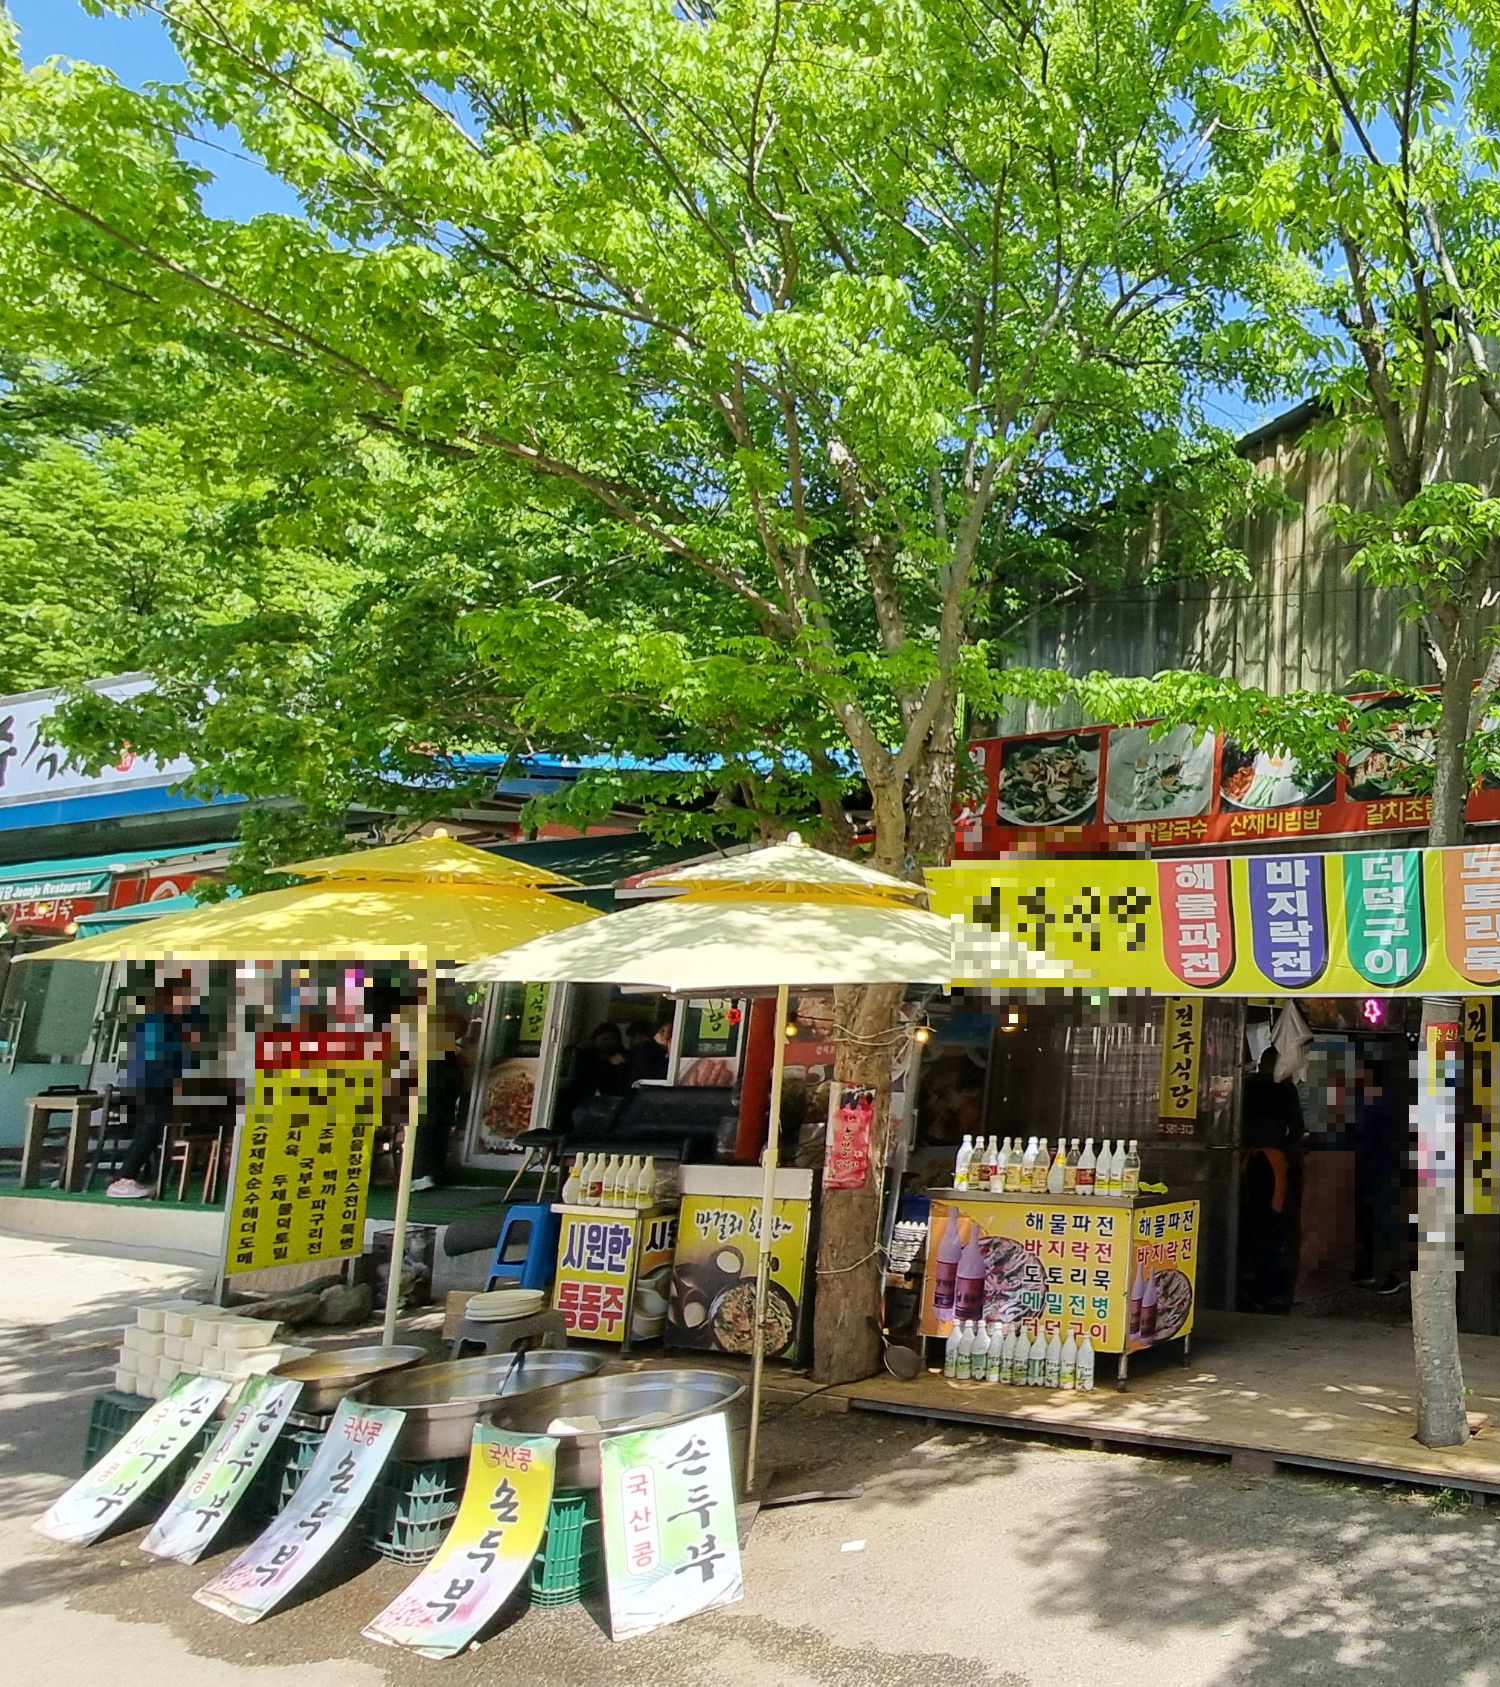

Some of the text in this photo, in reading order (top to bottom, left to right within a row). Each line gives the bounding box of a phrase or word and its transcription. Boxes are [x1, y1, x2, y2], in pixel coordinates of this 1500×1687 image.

[1230, 809, 1322, 836] 산채비빔밥
[42, 879, 92, 895] Restaurant
[1175, 863, 1221, 978] 해물파전
[1265, 860, 1313, 978] 바지락전
[1361, 855, 1409, 977] 더덕구이
[1170, 1004, 1195, 1108] 전주식당
[696, 1210, 743, 1241] 막걸리
[1025, 1212, 1114, 1237] 해물파전
[1139, 1209, 1194, 1238] 해물파전
[562, 1222, 632, 1272] 시원한
[1024, 1239, 1113, 1264] 바지락전
[1137, 1237, 1192, 1266] 바지락전
[1023, 1264, 1111, 1291] 도토리묵
[558, 1282, 624, 1333] 동동주
[1022, 1291, 1109, 1319] 메밀전병
[343, 1416, 384, 1447] 국산콩
[488, 1441, 533, 1472] 국산콩
[255, 1449, 356, 1587] 손두부
[626, 1473, 655, 1567] 국산콩
[666, 1434, 726, 1583] 손두부
[426, 1477, 519, 1622] 손두부
